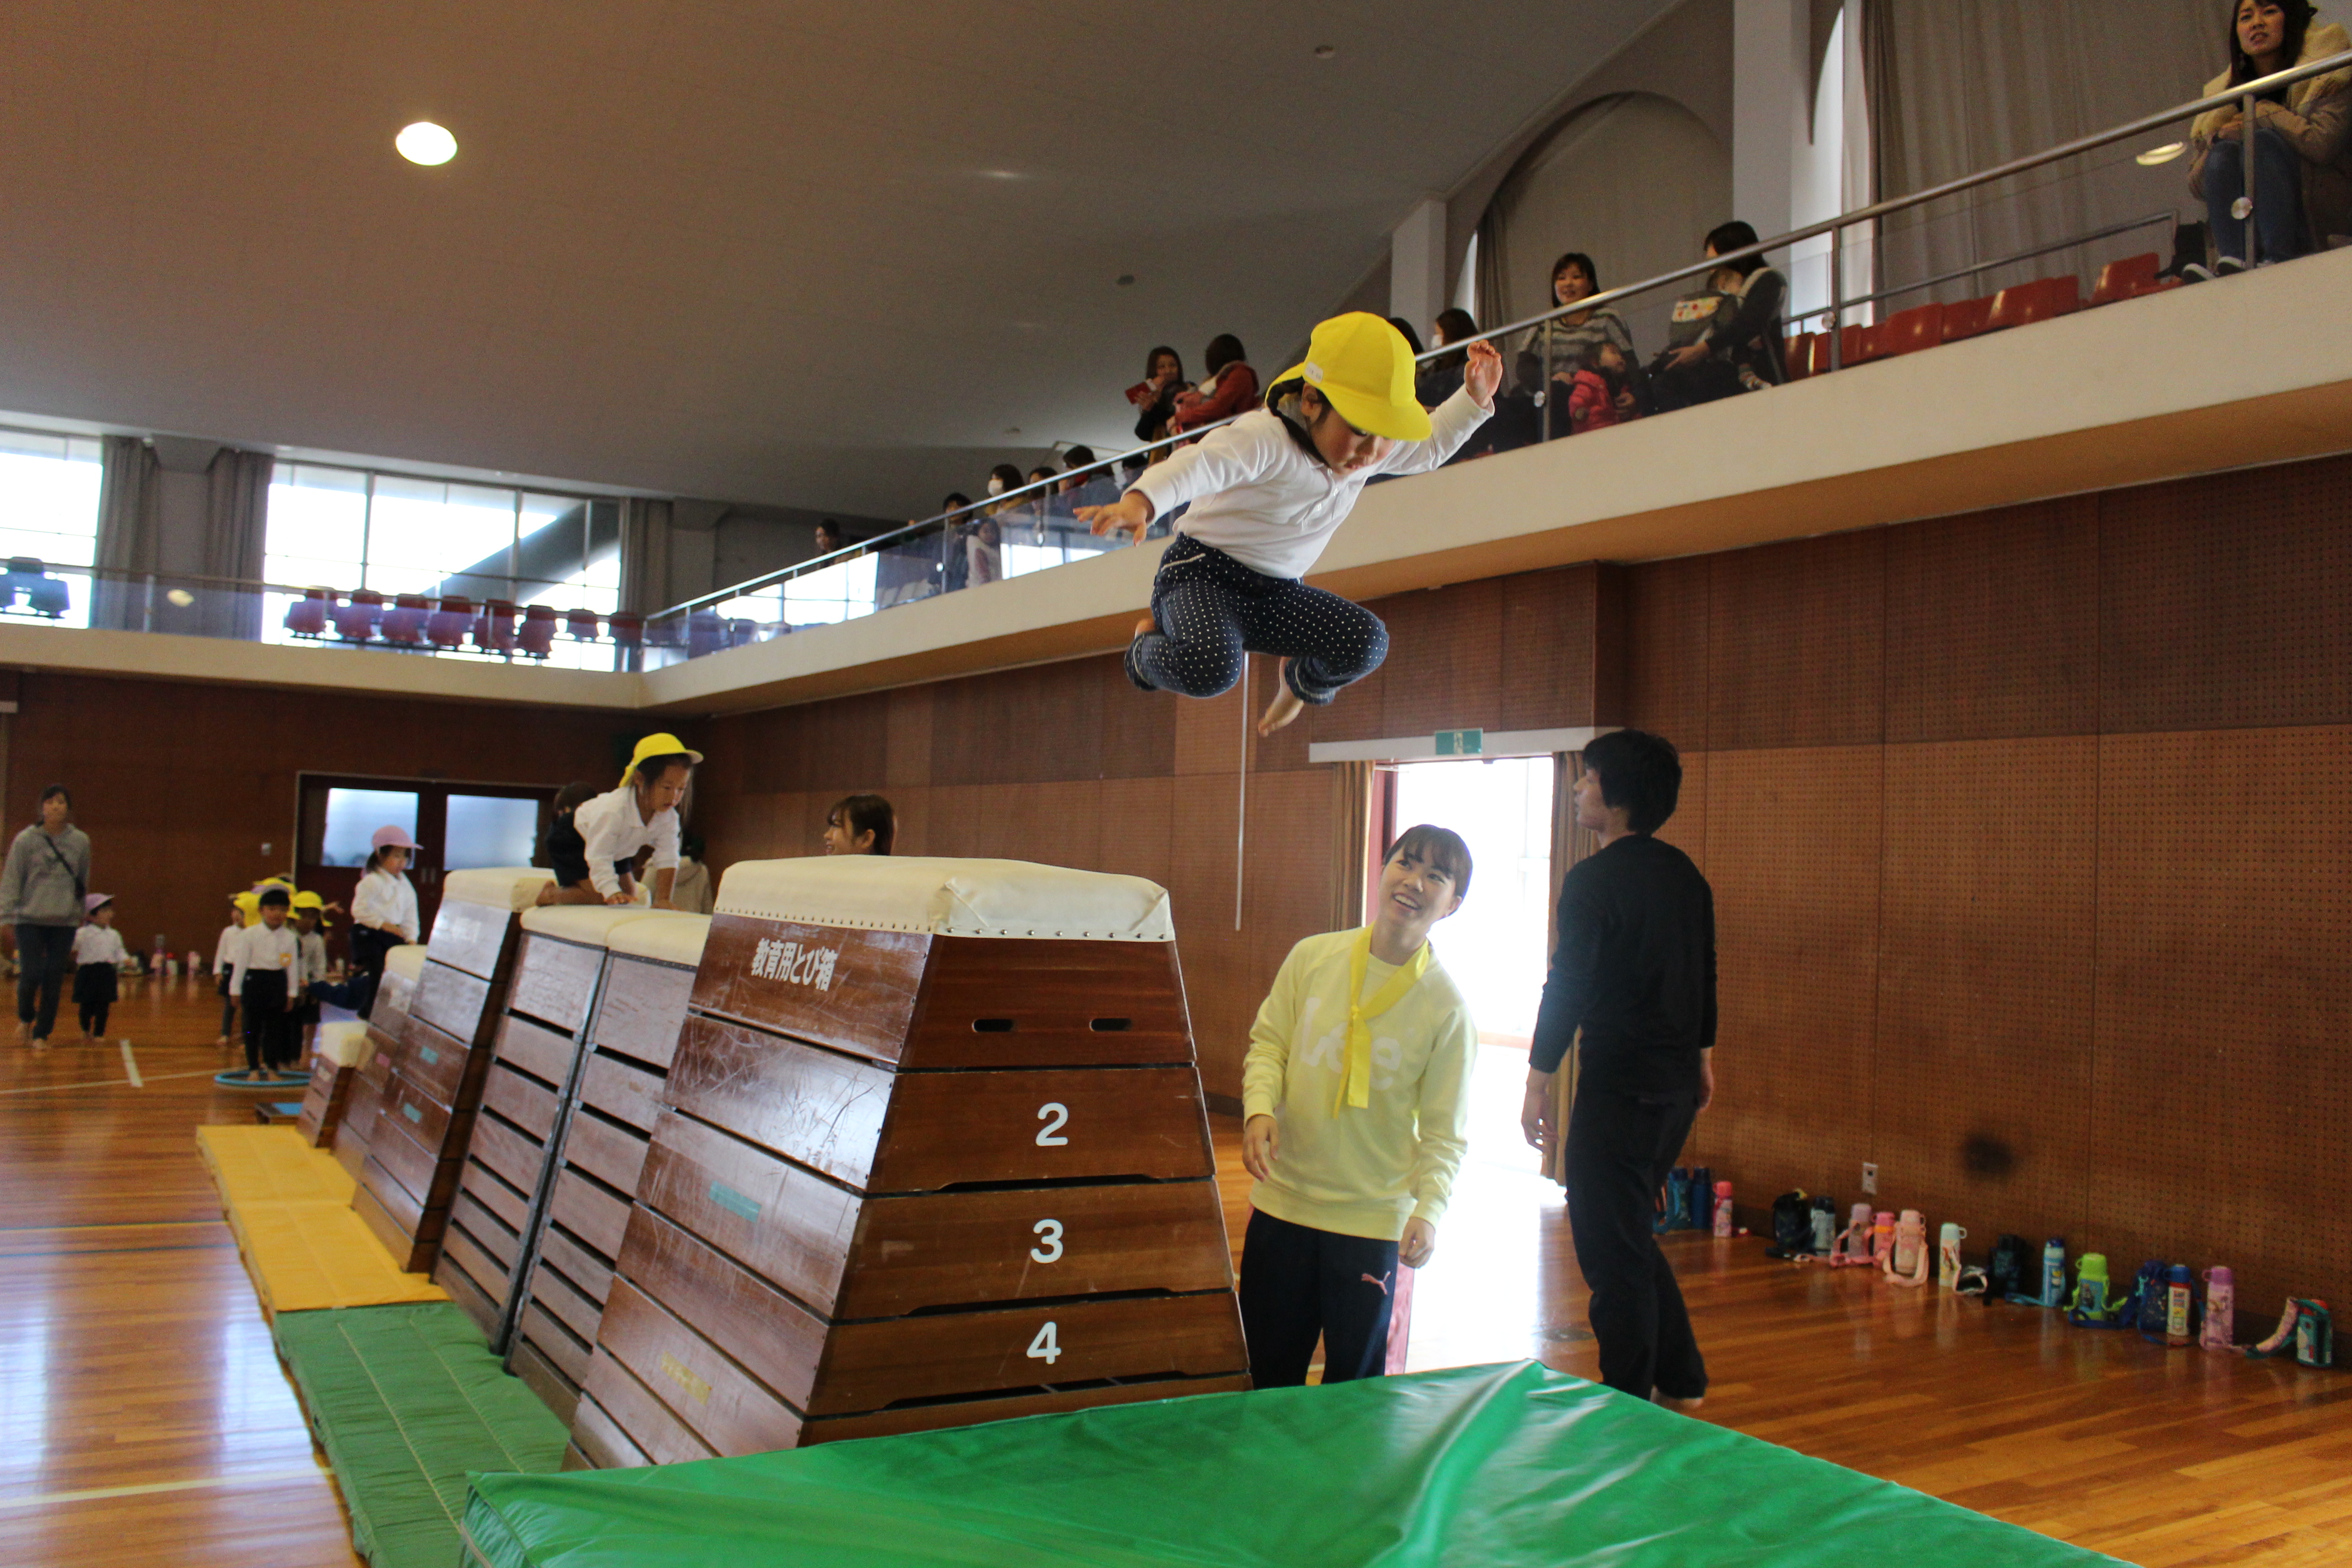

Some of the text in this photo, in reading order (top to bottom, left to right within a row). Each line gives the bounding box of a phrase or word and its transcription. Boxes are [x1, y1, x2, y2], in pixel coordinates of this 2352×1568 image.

[751, 937, 838, 992] 教育用とび箱
[1035, 1102, 1068, 1146] 2
[1030, 1219, 1063, 1264] 3
[1026, 1321, 1062, 1365] 4
